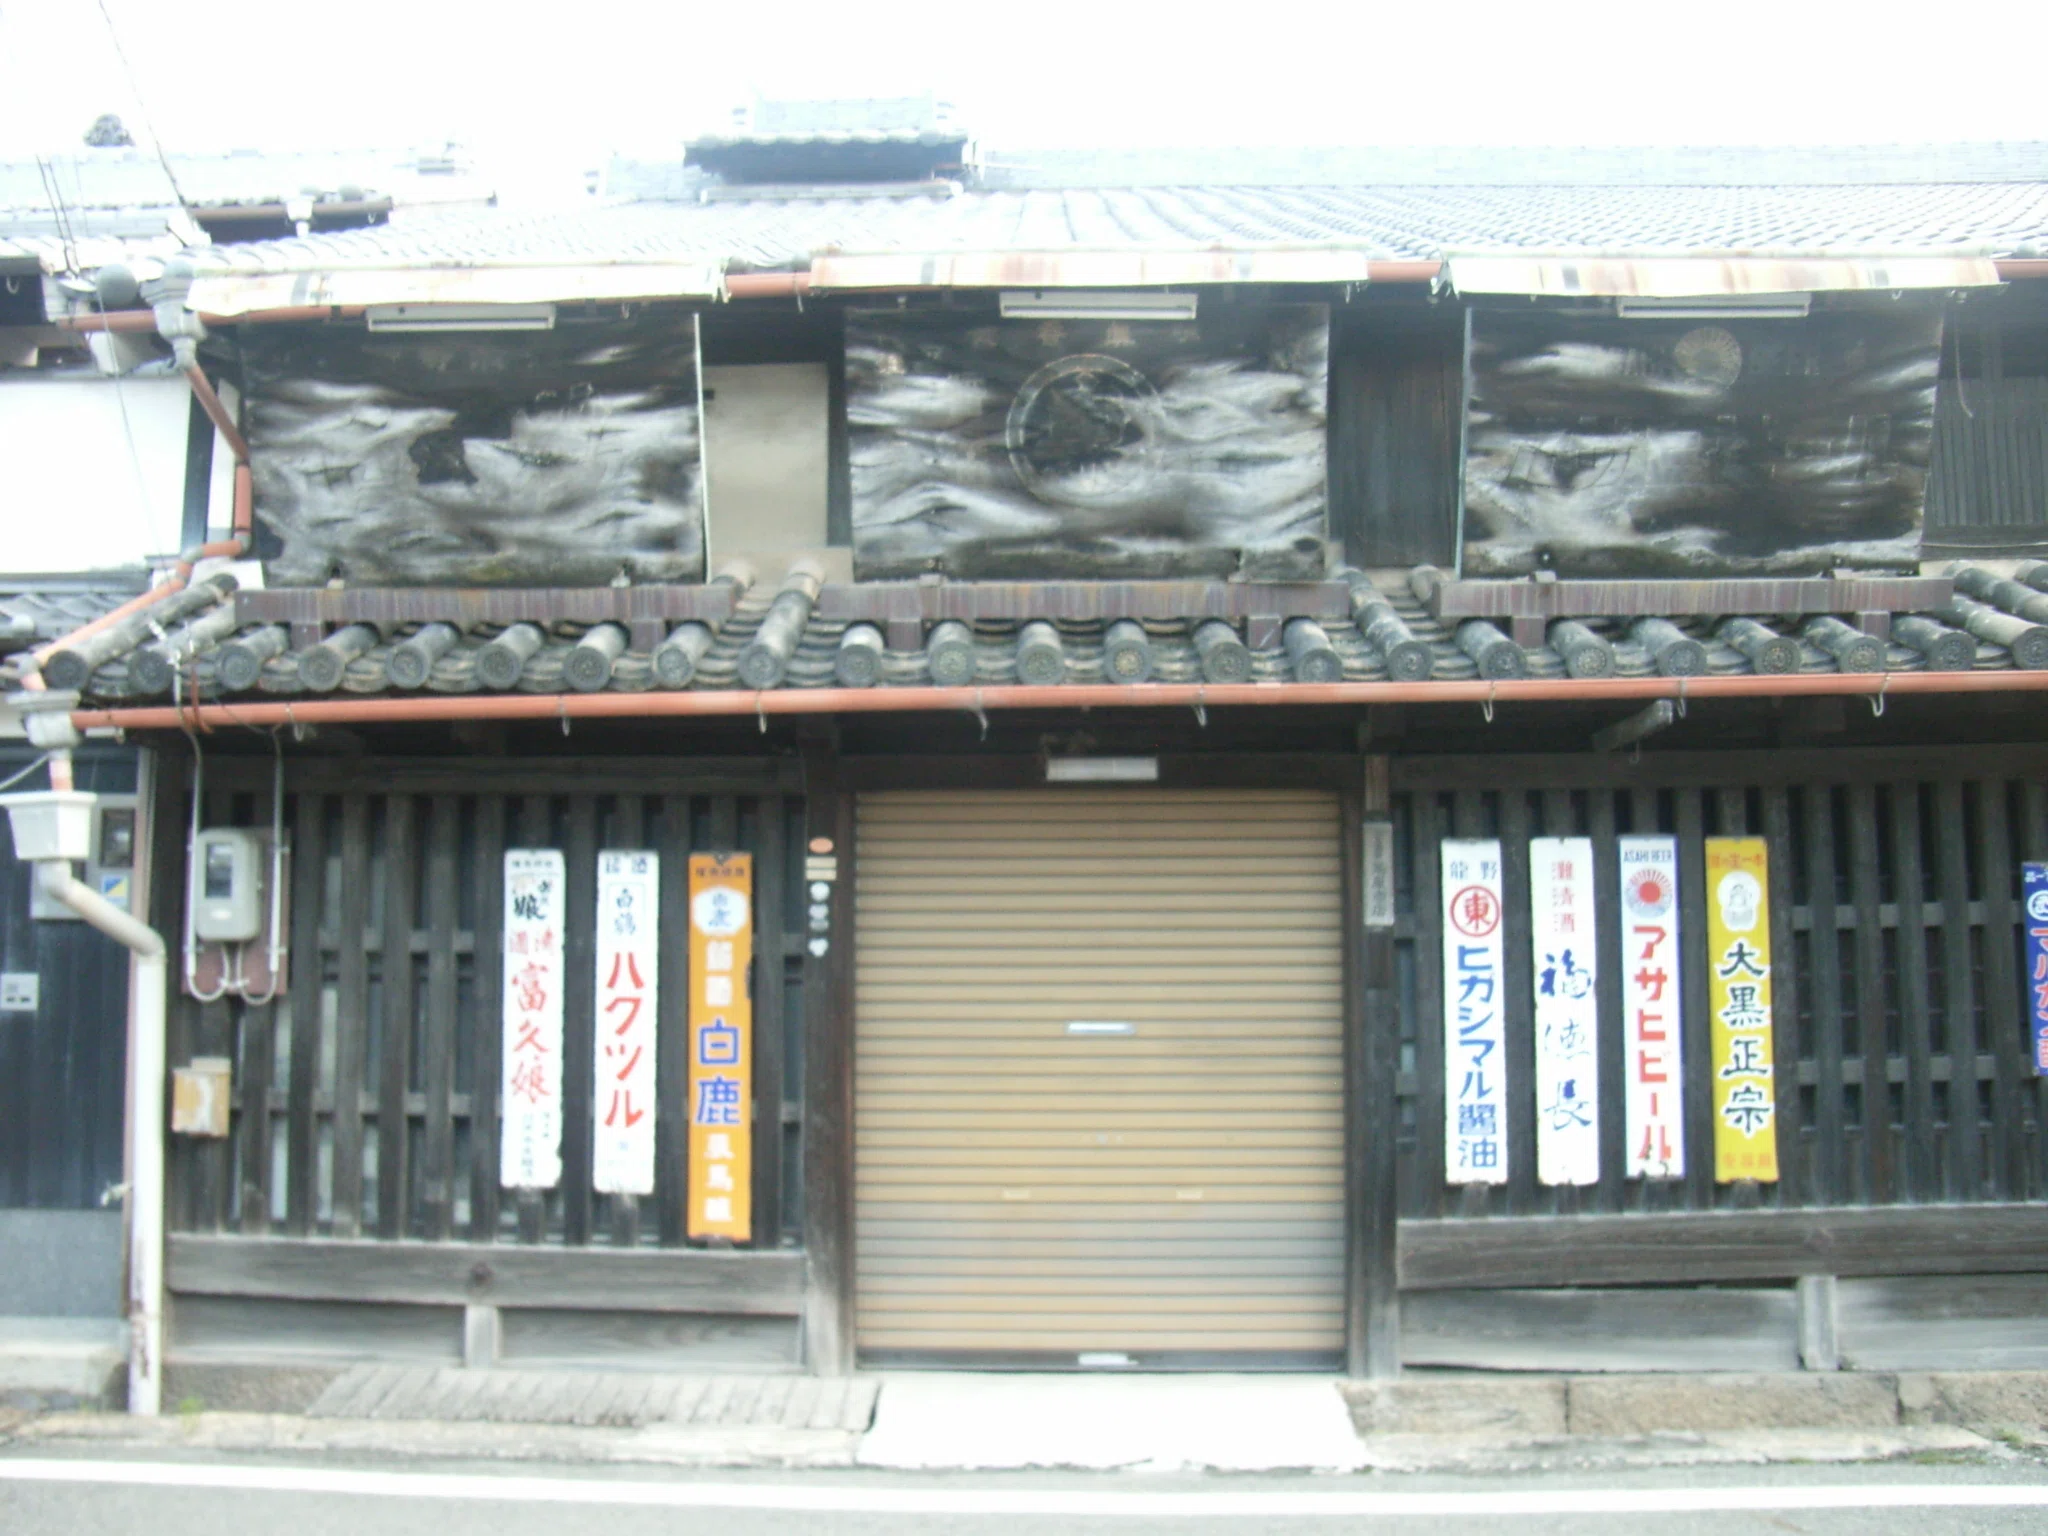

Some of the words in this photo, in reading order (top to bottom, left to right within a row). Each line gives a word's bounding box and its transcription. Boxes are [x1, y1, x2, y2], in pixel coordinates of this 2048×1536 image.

[1624, 849, 1649, 862] ASAHI
[1651, 849, 1672, 862] BEER
[511, 961, 551, 1104] 富久娘
[604, 951, 646, 1128] ハクツル
[695, 1018, 741, 1124] 白鹿
[1632, 924, 1672, 1162] アサヒビール
[1721, 942, 1770, 1133] 大黒正宗
